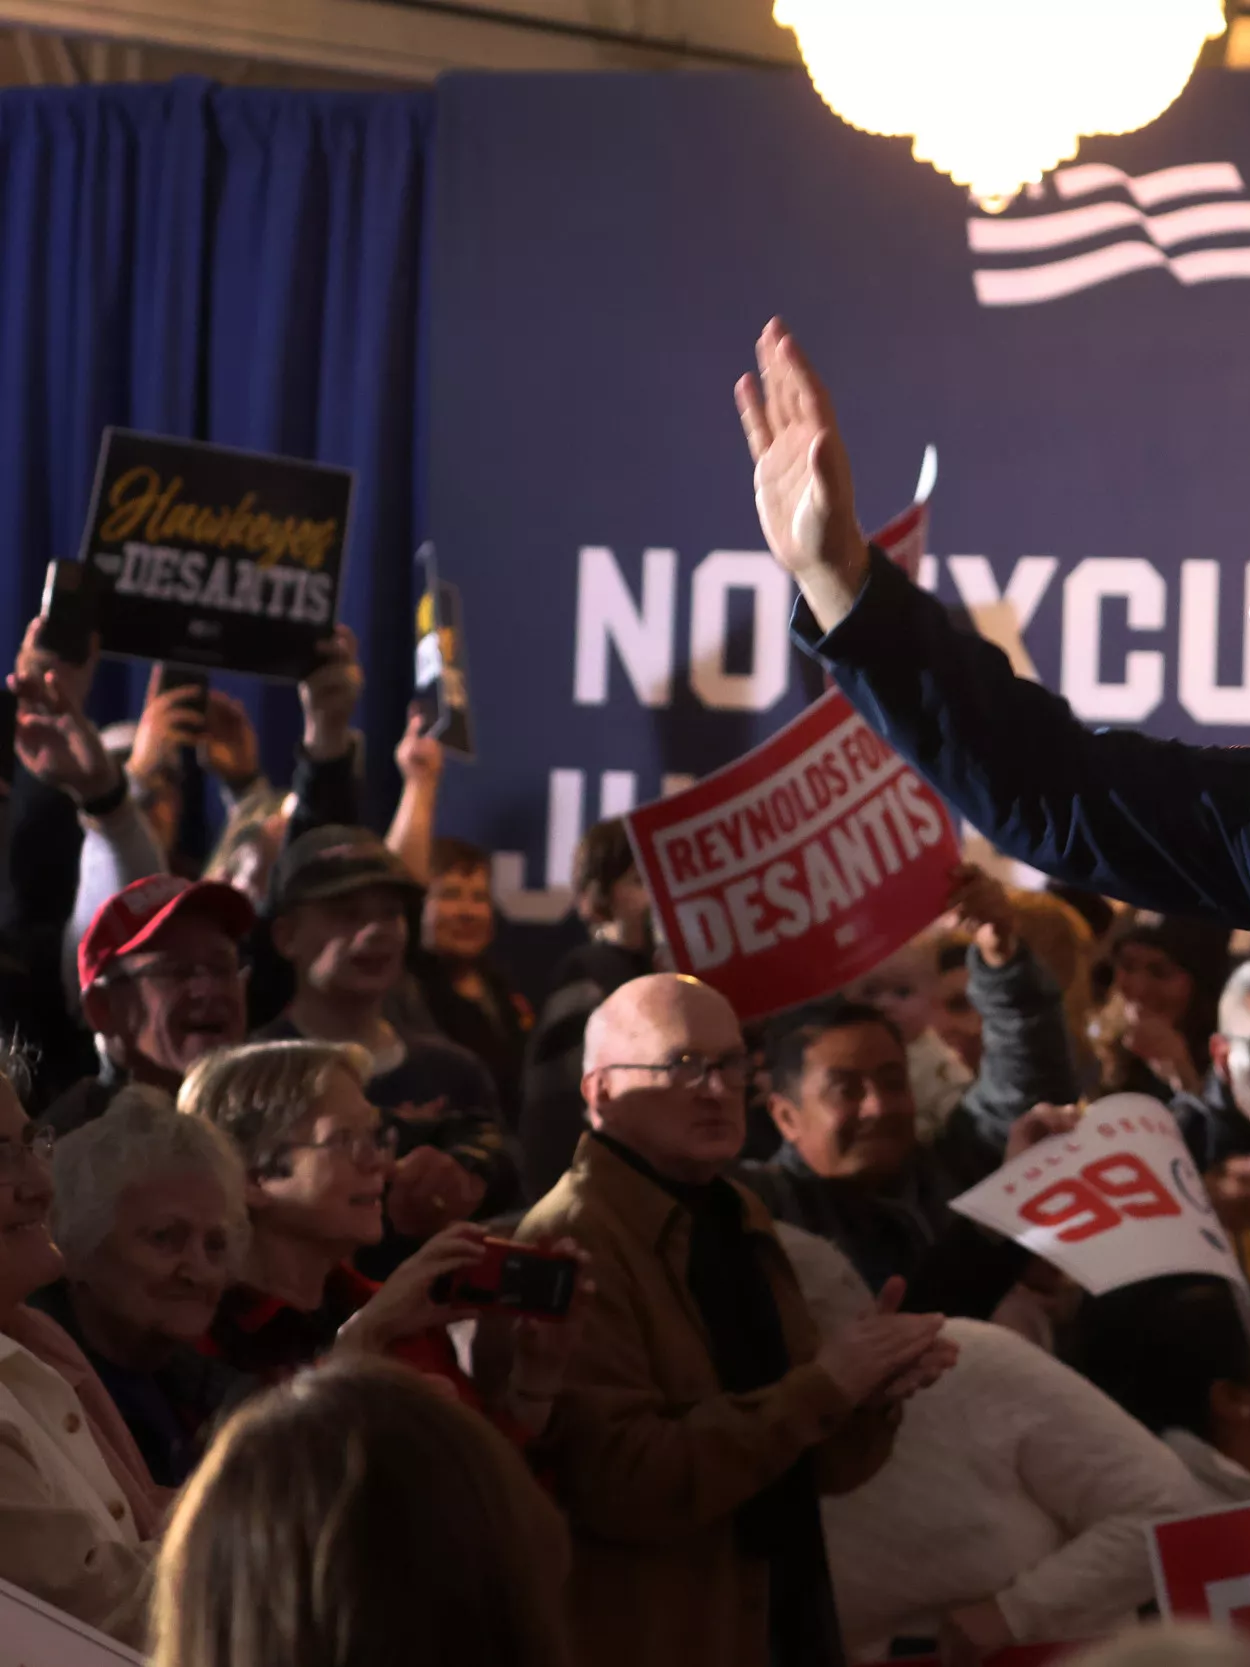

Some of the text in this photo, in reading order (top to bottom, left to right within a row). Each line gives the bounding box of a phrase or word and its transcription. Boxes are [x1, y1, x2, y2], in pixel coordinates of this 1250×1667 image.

[114, 541, 333, 625] DESANTIS
[573, 545, 794, 713] NO
[665, 751, 849, 886] REYNOLDS
[674, 771, 944, 971] DESANTIS
[1018, 1152, 1182, 1243] 99
